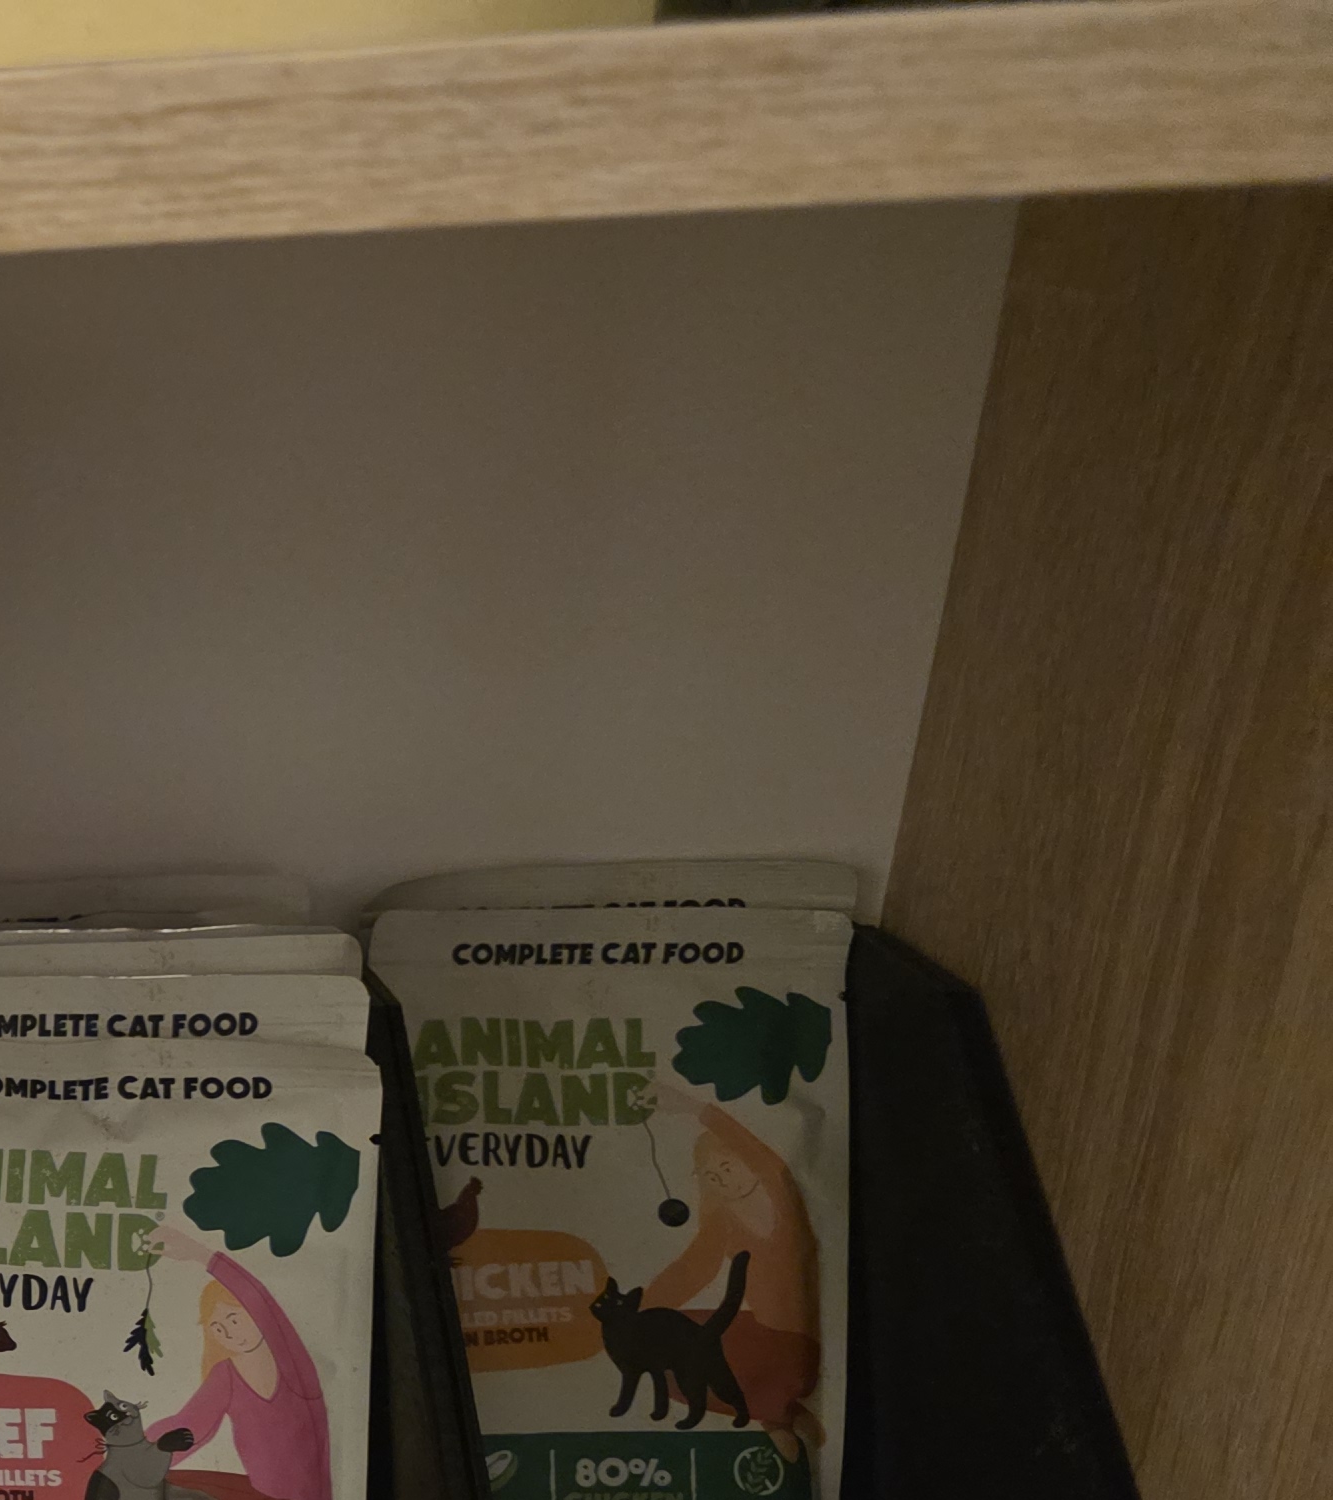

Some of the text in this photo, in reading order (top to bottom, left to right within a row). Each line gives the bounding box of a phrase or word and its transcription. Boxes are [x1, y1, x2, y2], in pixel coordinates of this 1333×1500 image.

[452, 941, 745, 966] COMPLETE CAT FOOD
[106, 1013, 165, 1038] CAT
[171, 1012, 259, 1037] FOOD
[412, 1016, 657, 1071] ANIMAL
[116, 1076, 176, 1100] CAT
[183, 1076, 274, 1100] FOOD
[427, 1131, 593, 1170] VERYDAY
[450, 1258, 597, 1301] ICKEN
[501, 1306, 573, 1325] FILLETS
[483, 1326, 550, 1346] BROTH
[574, 1456, 673, 1488] 80%
